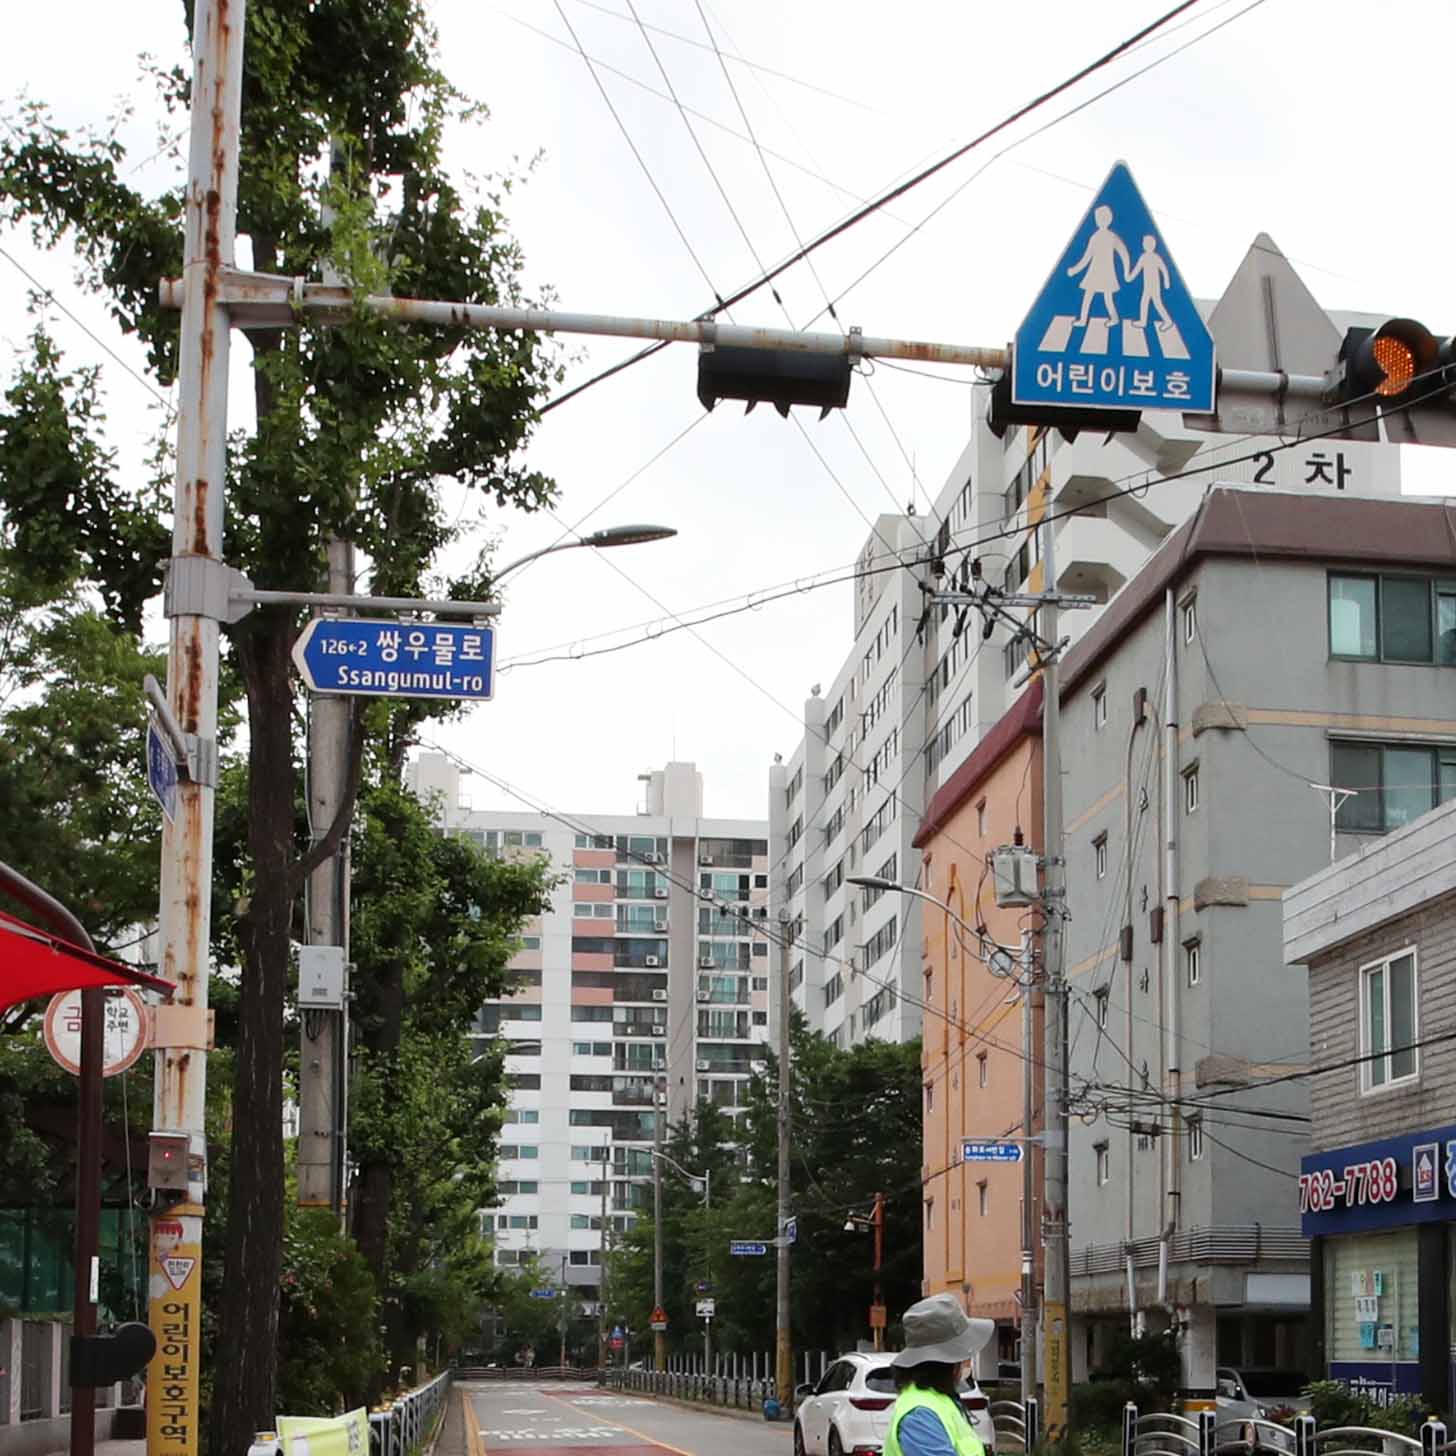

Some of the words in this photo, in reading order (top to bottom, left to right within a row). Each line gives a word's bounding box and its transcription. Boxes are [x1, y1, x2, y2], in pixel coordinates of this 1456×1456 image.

[1036, 361, 1192, 400] 어린이보호
[376, 630, 485, 666] 쌍우물로
[337, 665, 483, 691] Ssangumul-ro
[1299, 1157, 1397, 1214] 762-7788
[160, 1303, 189, 1445] 어린이보호구역
